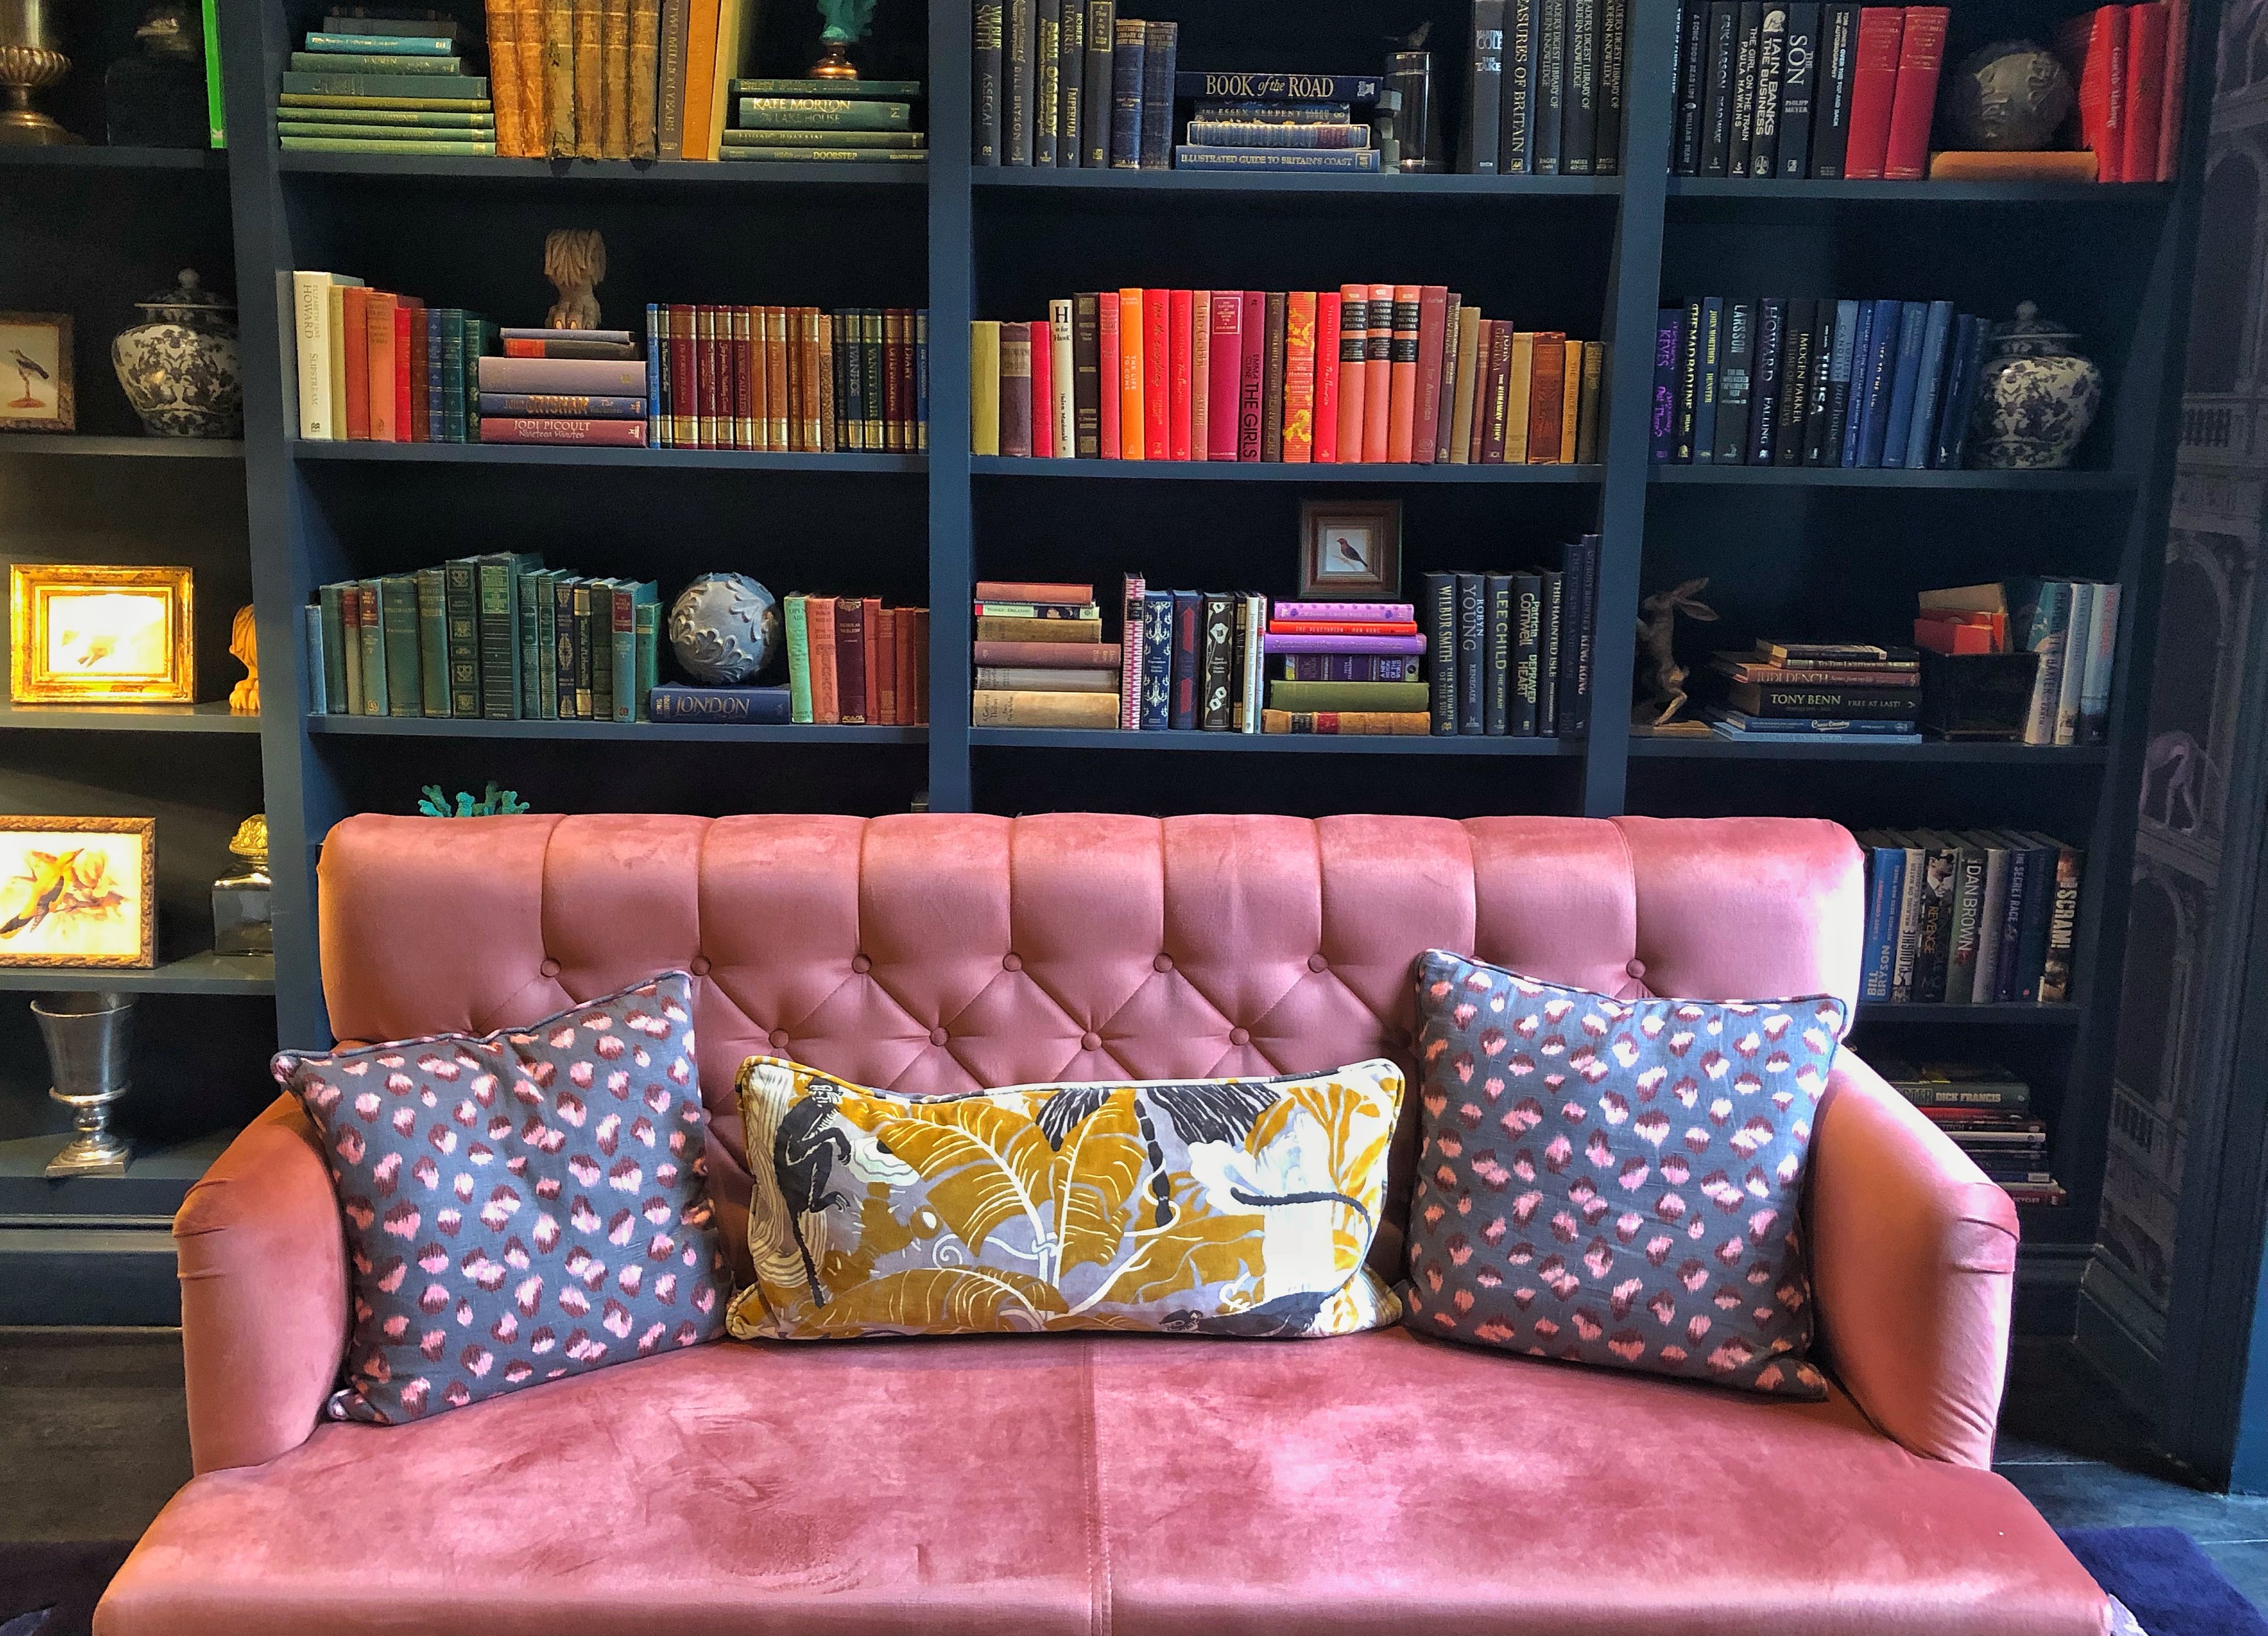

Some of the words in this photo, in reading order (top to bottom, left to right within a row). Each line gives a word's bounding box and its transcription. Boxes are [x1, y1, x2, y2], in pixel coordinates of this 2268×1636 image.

[976, 5, 989, 50] SMITH
[990, 7, 1002, 48] WILBUR
[1047, 22, 1058, 59] PAUL
[1064, 4, 1074, 54] HARRIS
[1476, 38, 1502, 50] COLE
[1552, 30, 1561, 61] DIGEST
[1721, 15, 1731, 41] ERIK
[1749, 27, 1757, 47] THE
[1584, 31, 1592, 63] DIGEST
[1739, 41, 1748, 75] PAULA
[1748, 49, 1756, 72] GIRL
[1763, 38, 1772, 64] THE
[1771, 38, 1782, 74] IAIN
[1787, 35, 1808, 85] SON
[1476, 62, 1501, 72] TAKE
[1515, 67, 1527, 87] OF
[1551, 62, 1560, 98] LIBRARY
[1582, 63, 1591, 100] LIBRARY
[1746, 74, 1754, 89] ON
[982, 73, 993, 126] ASSEGAI
[1206, 75, 1253, 95] BOOK
[1258, 77, 1270, 96] of
[1271, 80, 1285, 92] the
[1288, 77, 1334, 97] ROAD
[1551, 100, 1558, 108] OF
[1736, 79, 1744, 126] HAWKINS
[1744, 91, 1753, 111] THE
[1757, 69, 1769, 135] BUSINESS
[753, 98, 785, 110] KATE
[790, 99, 850, 112] MORTON
[804, 113, 840, 124] HOUSE
[1012, 96, 1022, 139] BRYSON
[1512, 91, 1526, 152] BRITAIN
[1581, 100, 1590, 110] OF
[1765, 82, 1779, 136] BANKS
[1742, 113, 1750, 141] TRAIN
[1181, 154, 1236, 164] ILLUSTRATED
[1239, 155, 1265, 164] GUIDE
[1268, 155, 1280, 164] TO
[1324, 157, 1353, 165] COAST
[303, 285, 314, 339] HOWARD
[1055, 307, 1068, 323] H
[1731, 306, 1747, 353] LARSSON
[1762, 307, 1778, 381] HOWARD
[1795, 333, 1809, 379] IMOGEN
[850, 345, 860, 397] IVANHOE
[867, 348, 878, 389] VANITY
[526, 396, 589, 414] GRISHAM
[868, 391, 878, 417] FAIR
[1245, 382, 1258, 409] THE
[1793, 384, 1804, 423] PARKER
[514, 420, 539, 430] JODI
[544, 421, 590, 431] PICOULT
[1243, 413, 1258, 458] GIRLS
[1760, 397, 1771, 444] FALLING
[1438, 585, 1452, 628] WILBUR
[1496, 590, 1509, 619] LEE
[1552, 579, 1561, 604] THIS
[1463, 584, 1477, 651] YOUNG
[1476, 599, 1484, 637] ROBYN
[1531, 600, 1541, 637] Patricia
[1549, 606, 1560, 655] HAUNTED
[1438, 631, 1453, 663] SMITH
[1495, 622, 1508, 670] CHILD
[1517, 661, 1528, 697] HEART
[1527, 654, 1538, 704] DEPRAVED
[1548, 657, 1557, 677] ISLE
[675, 696, 750, 716] LONDON
[1770, 694, 1805, 704] TONY
[1808, 695, 1840, 705] BENN
[1967, 862, 1981, 895] DAN
[2013, 866, 2025, 899] SECRET
[1958, 899, 1977, 951] BROWN
[2009, 900, 2022, 923] RACE
[2051, 886, 2076, 949] SCRAM!
[1924, 906, 1939, 954] REVENGE
[1900, 930, 1916, 973] CLOUGHIE
[1867, 972, 1878, 995] BILL
[1877, 945, 1890, 996] BRYSON
